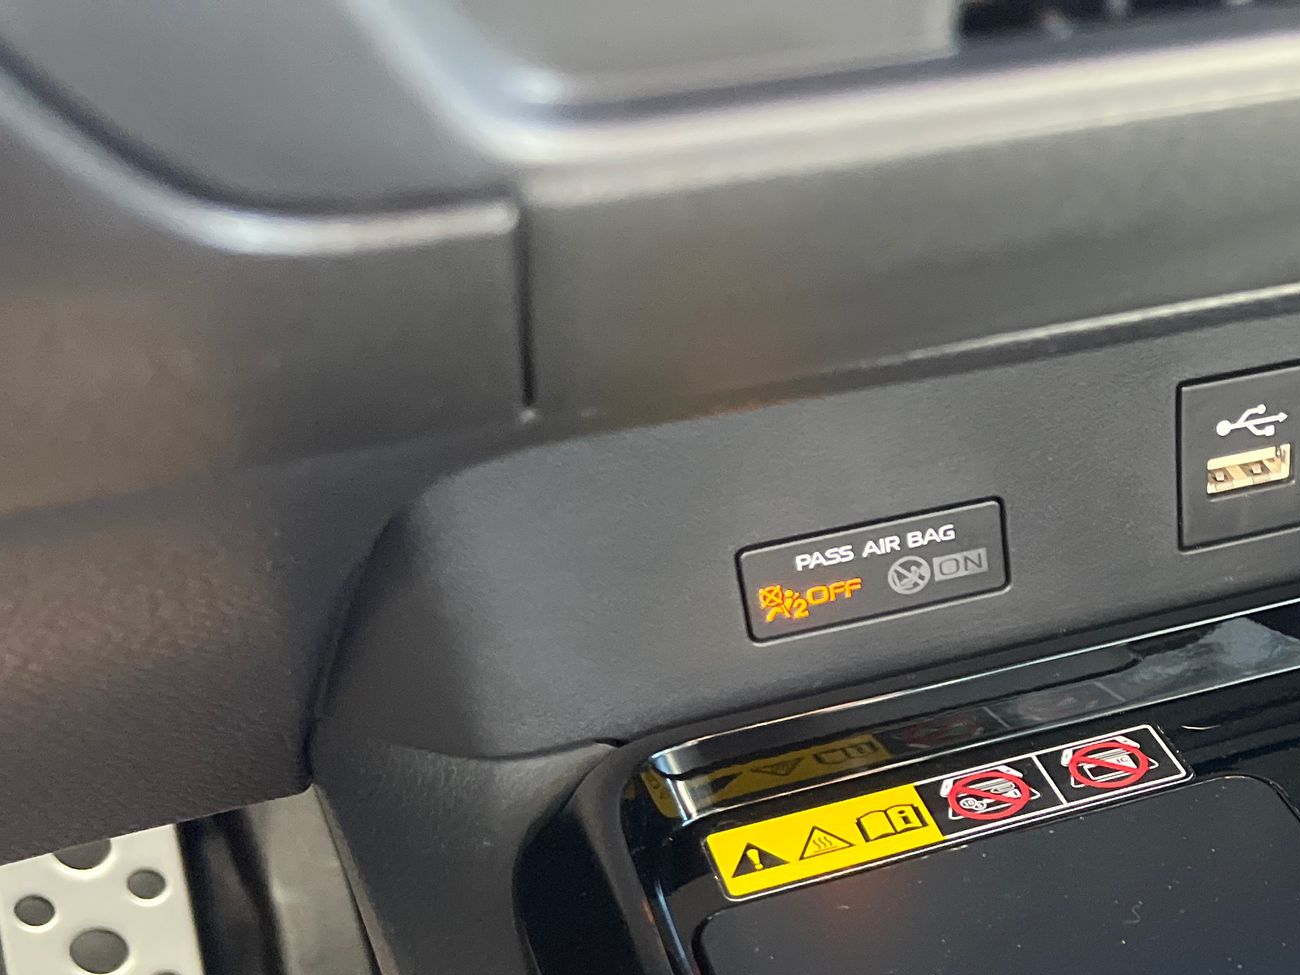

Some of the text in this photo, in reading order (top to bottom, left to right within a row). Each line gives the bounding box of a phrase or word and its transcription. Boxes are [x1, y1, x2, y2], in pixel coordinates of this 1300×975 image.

[796, 524, 956, 572] PASS AIR BAG
[939, 553, 983, 576] ON
[807, 578, 862, 605] OFF
